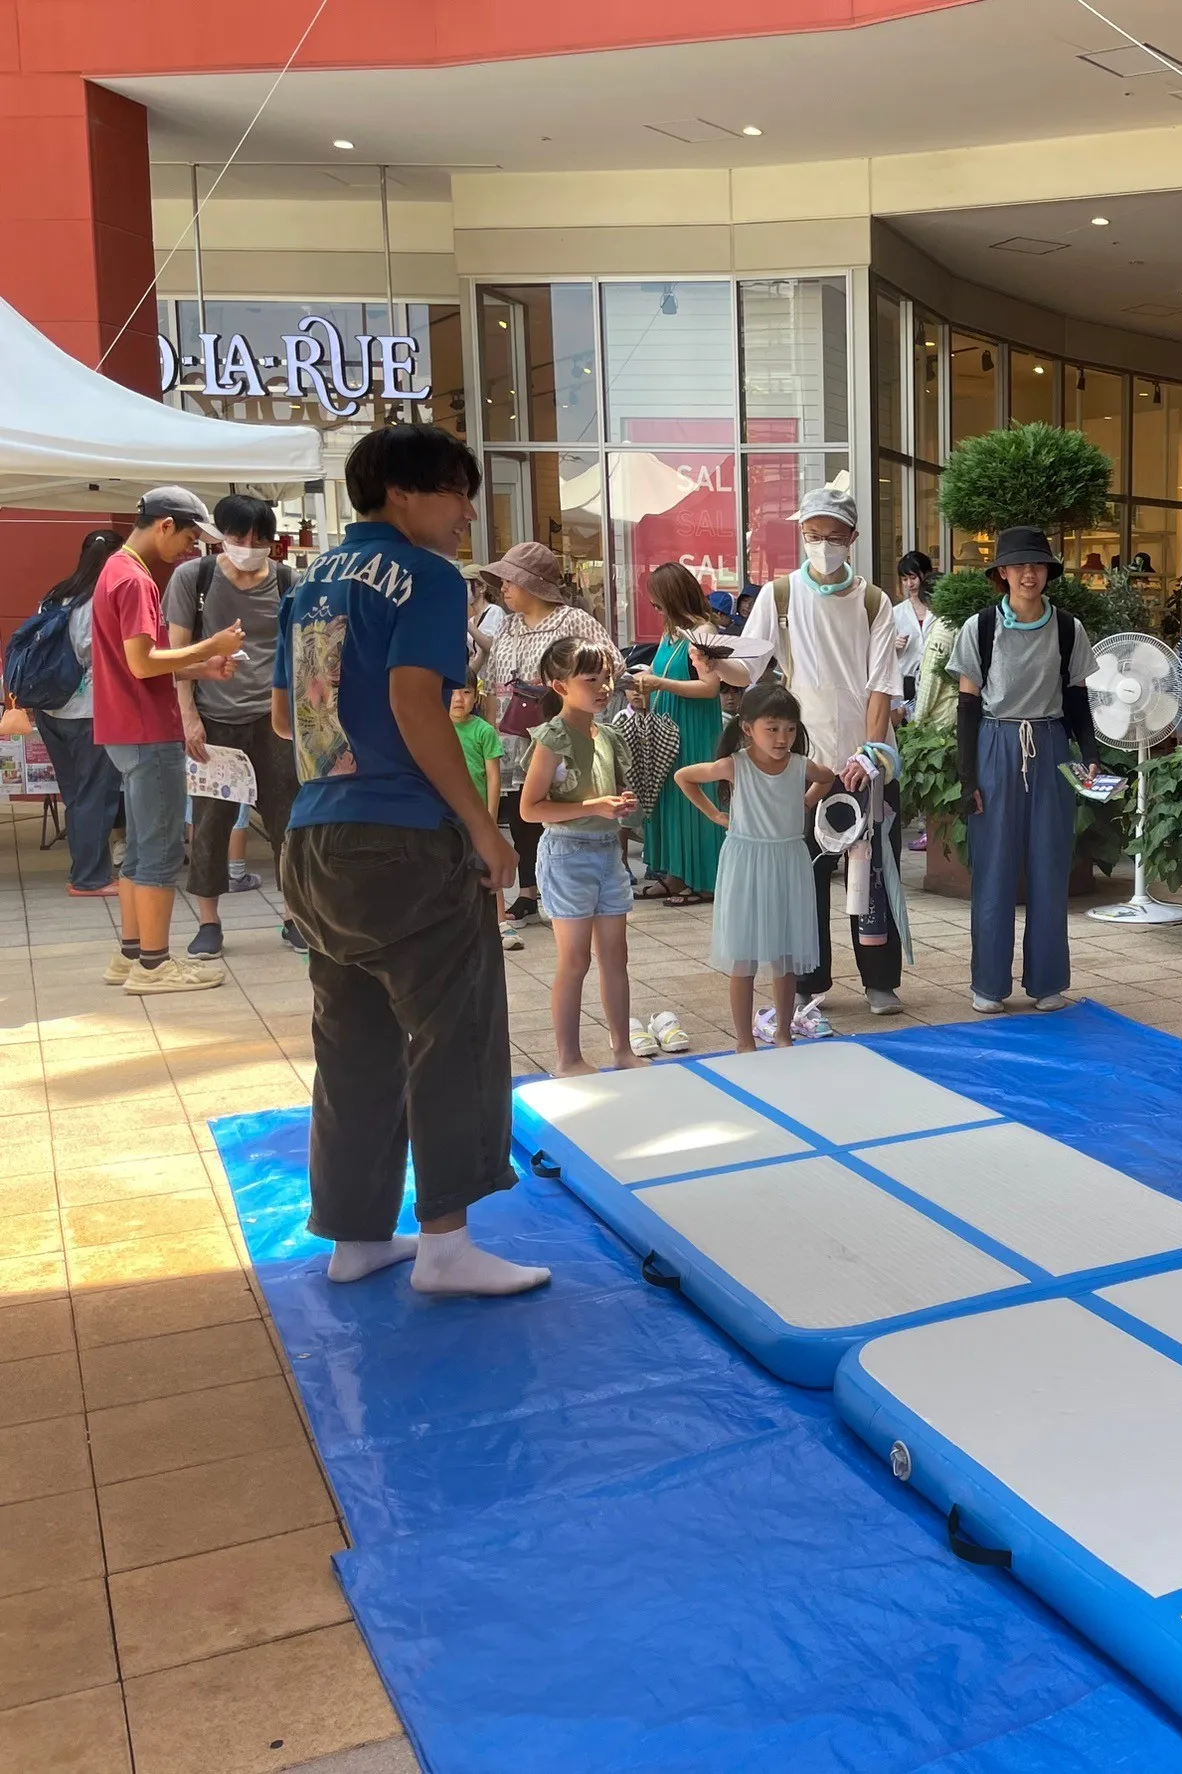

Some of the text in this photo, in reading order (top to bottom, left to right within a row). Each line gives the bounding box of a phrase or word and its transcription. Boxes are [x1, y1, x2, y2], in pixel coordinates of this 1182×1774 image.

[677, 465, 738, 492] SAL
[676, 509, 734, 537] SAL
[679, 554, 739, 581] SAL
